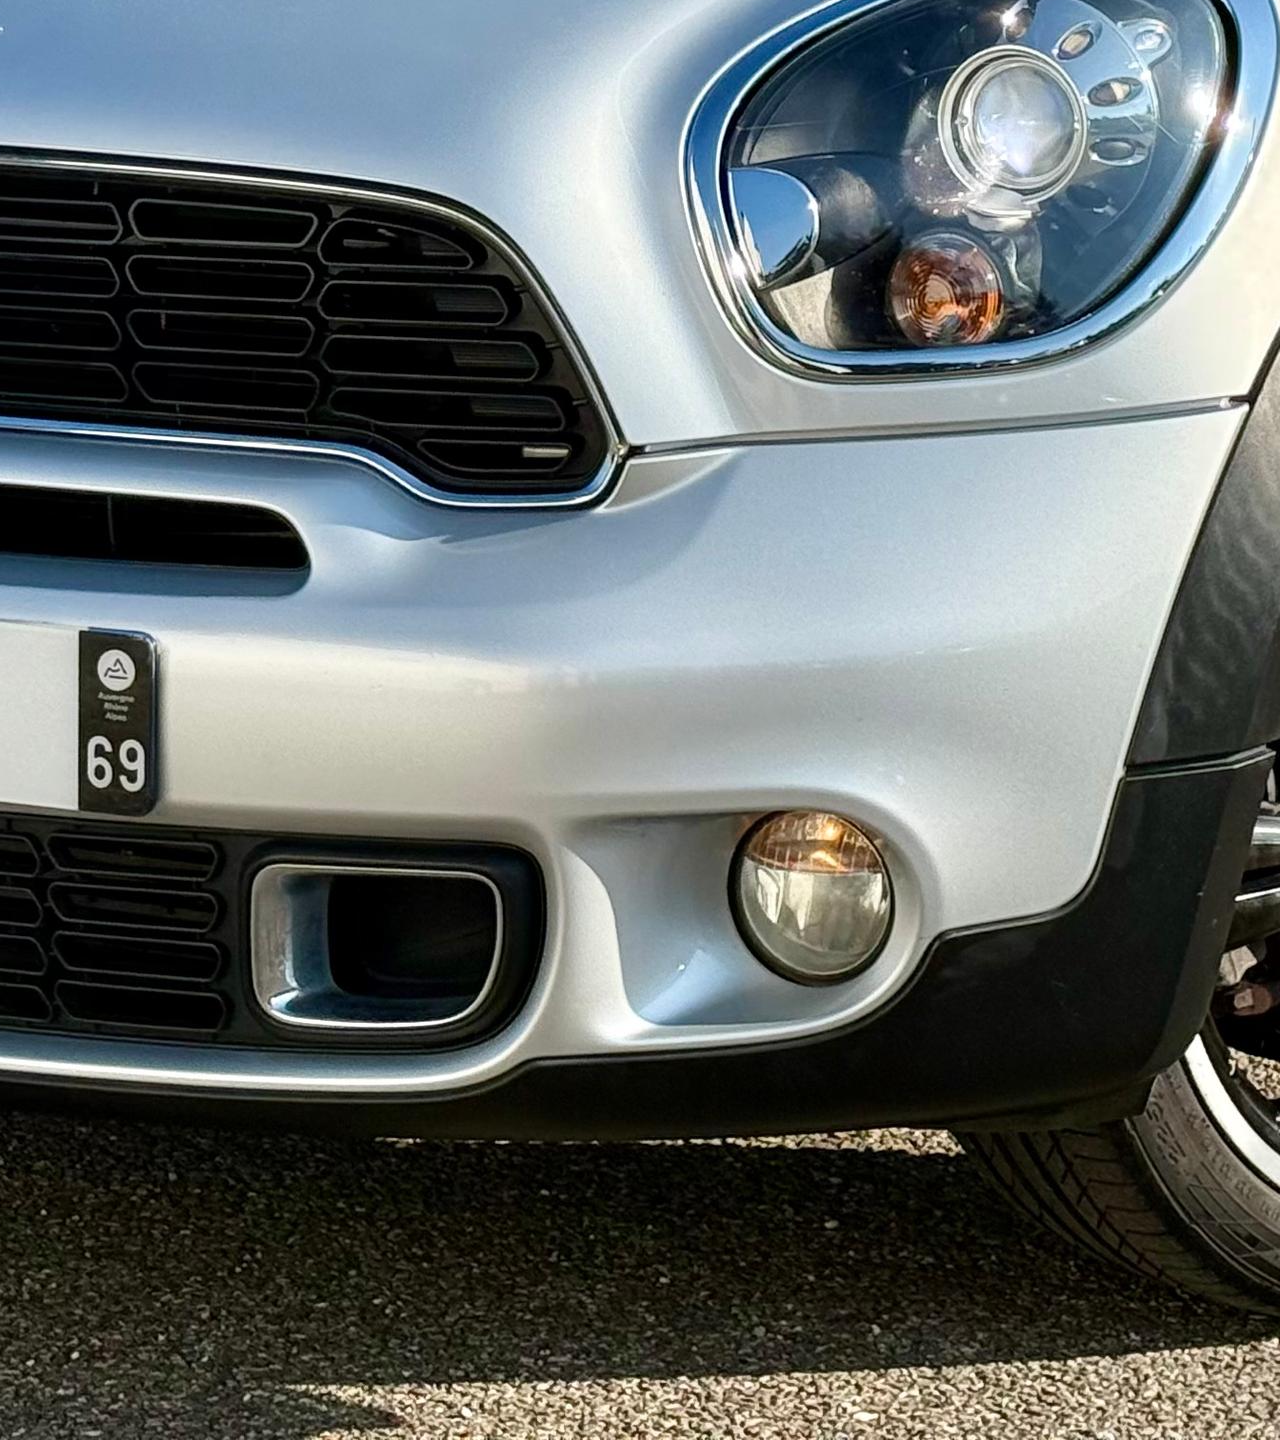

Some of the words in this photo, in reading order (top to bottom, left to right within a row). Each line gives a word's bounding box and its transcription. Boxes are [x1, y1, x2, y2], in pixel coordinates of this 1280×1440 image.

[98, 691, 135, 703] Auvergne
[105, 713, 128, 722] Alpes
[86, 734, 146, 793] 69
